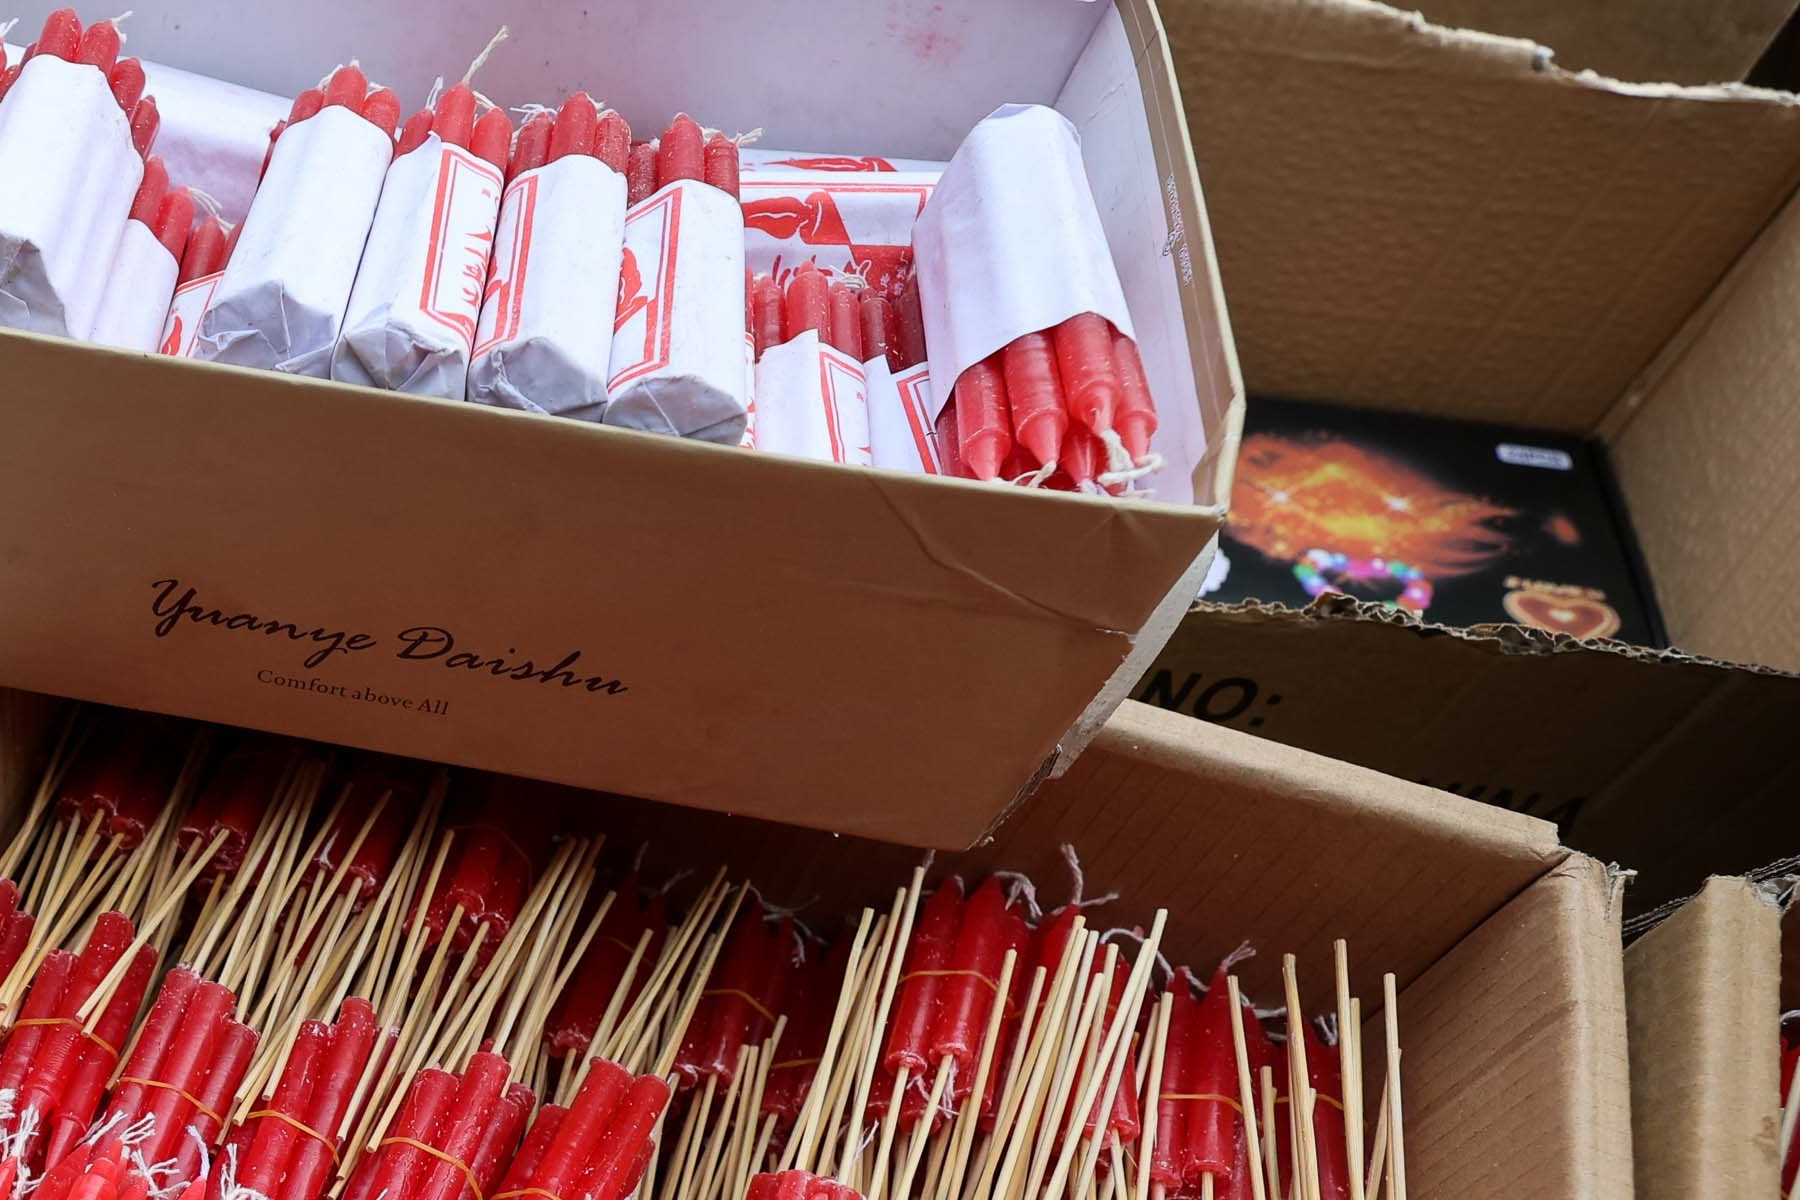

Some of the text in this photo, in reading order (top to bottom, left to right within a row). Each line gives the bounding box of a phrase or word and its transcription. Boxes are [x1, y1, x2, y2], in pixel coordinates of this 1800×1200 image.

[151, 578, 629, 697] Yuanye Daishu
[256, 668, 450, 717] Comfort above All
[1140, 668, 1283, 727] NO:
